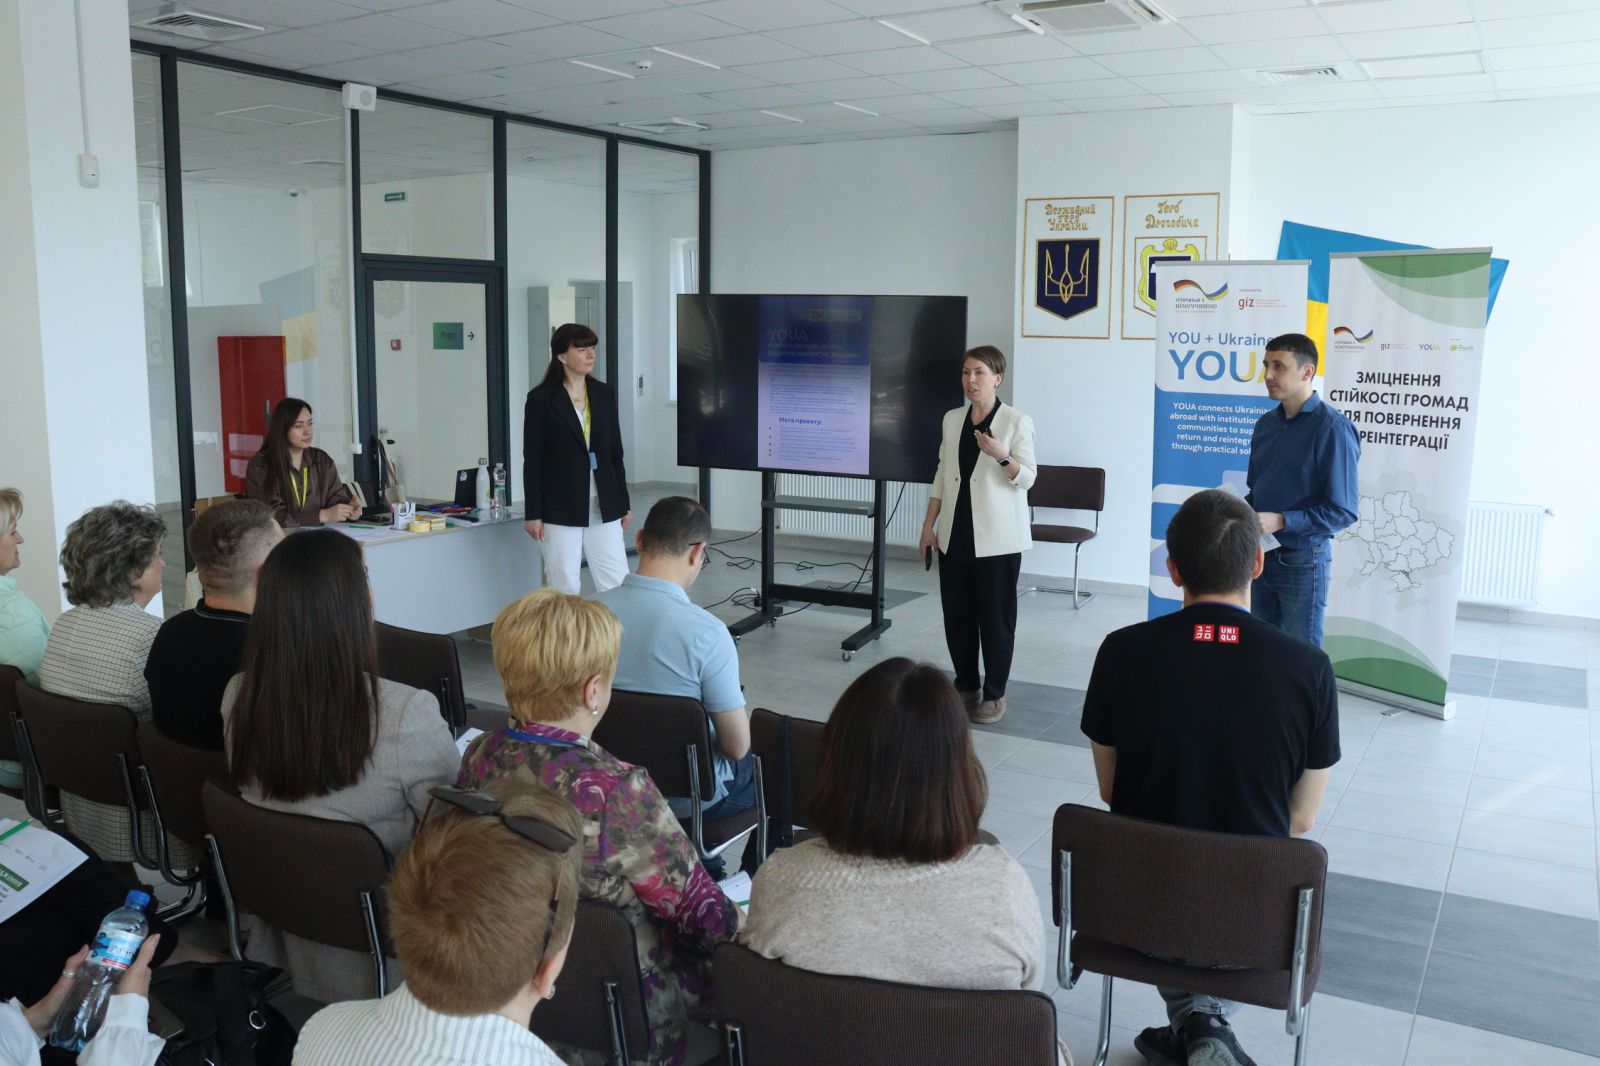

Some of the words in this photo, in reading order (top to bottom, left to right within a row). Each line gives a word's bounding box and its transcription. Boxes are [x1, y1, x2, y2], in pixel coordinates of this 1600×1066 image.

[1238, 296, 1255, 310] giz
[1168, 332, 1200, 345] YOU
[1356, 371, 1441, 387] ЗМІЦНЕННЯ
[1330, 388, 1400, 405] СТІЙКОСТІ
[1404, 393, 1469, 412] ГРОМАД
[1173, 402, 1197, 411] YOUA
[1197, 404, 1233, 413] connects
[1169, 412, 1198, 421] abroad
[1198, 414, 1216, 422] with
[1338, 409, 1361, 422] ЛЯ
[1364, 411, 1461, 430] ПОВЕРНЕННЯ
[1177, 424, 1228, 433] communities
[1176, 433, 1201, 441] return
[1360, 430, 1450, 451] РЕІНТЕГРАЦІЇ
[1171, 442, 1203, 453] through
[1203, 445, 1238, 454] practical
[1220, 634, 1237, 642] QLO
